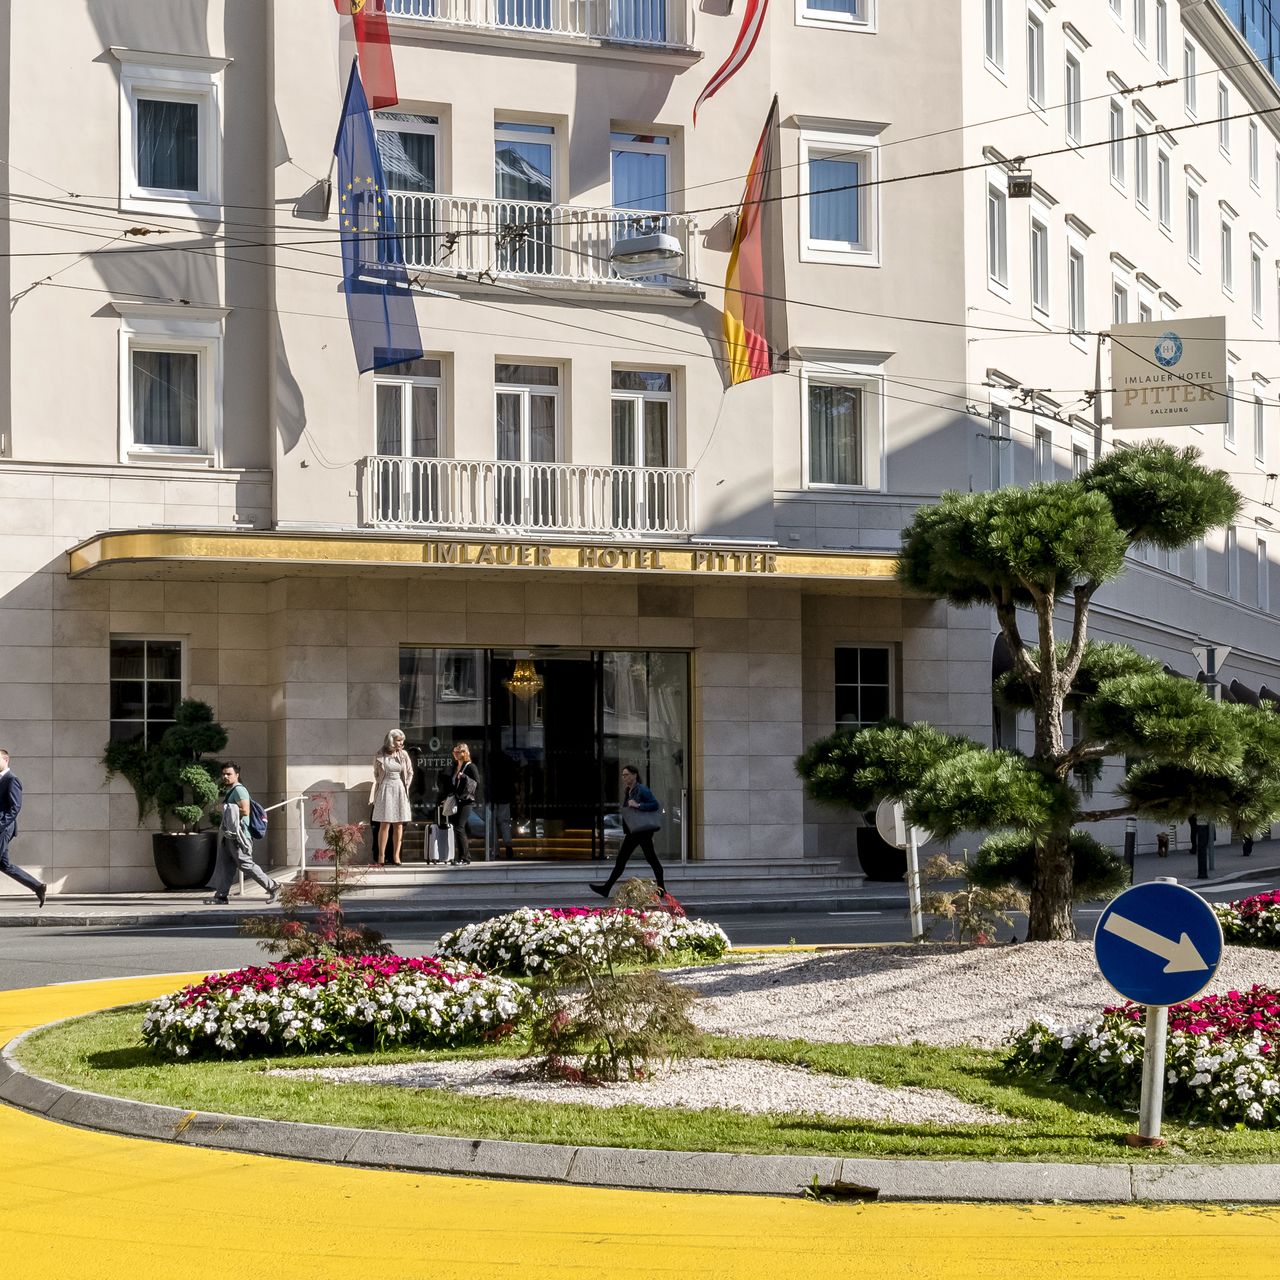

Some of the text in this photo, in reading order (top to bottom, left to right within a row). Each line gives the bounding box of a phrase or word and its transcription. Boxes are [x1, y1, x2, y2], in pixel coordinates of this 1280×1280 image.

[1124, 370, 1213, 385] IMLAUER HOTEL
[1123, 384, 1216, 407] PITTER
[1150, 406, 1189, 415] SALZBURG
[422, 541, 778, 573] IMLAUER HOTEL PITTER
[417, 758, 453, 767] PITTER
